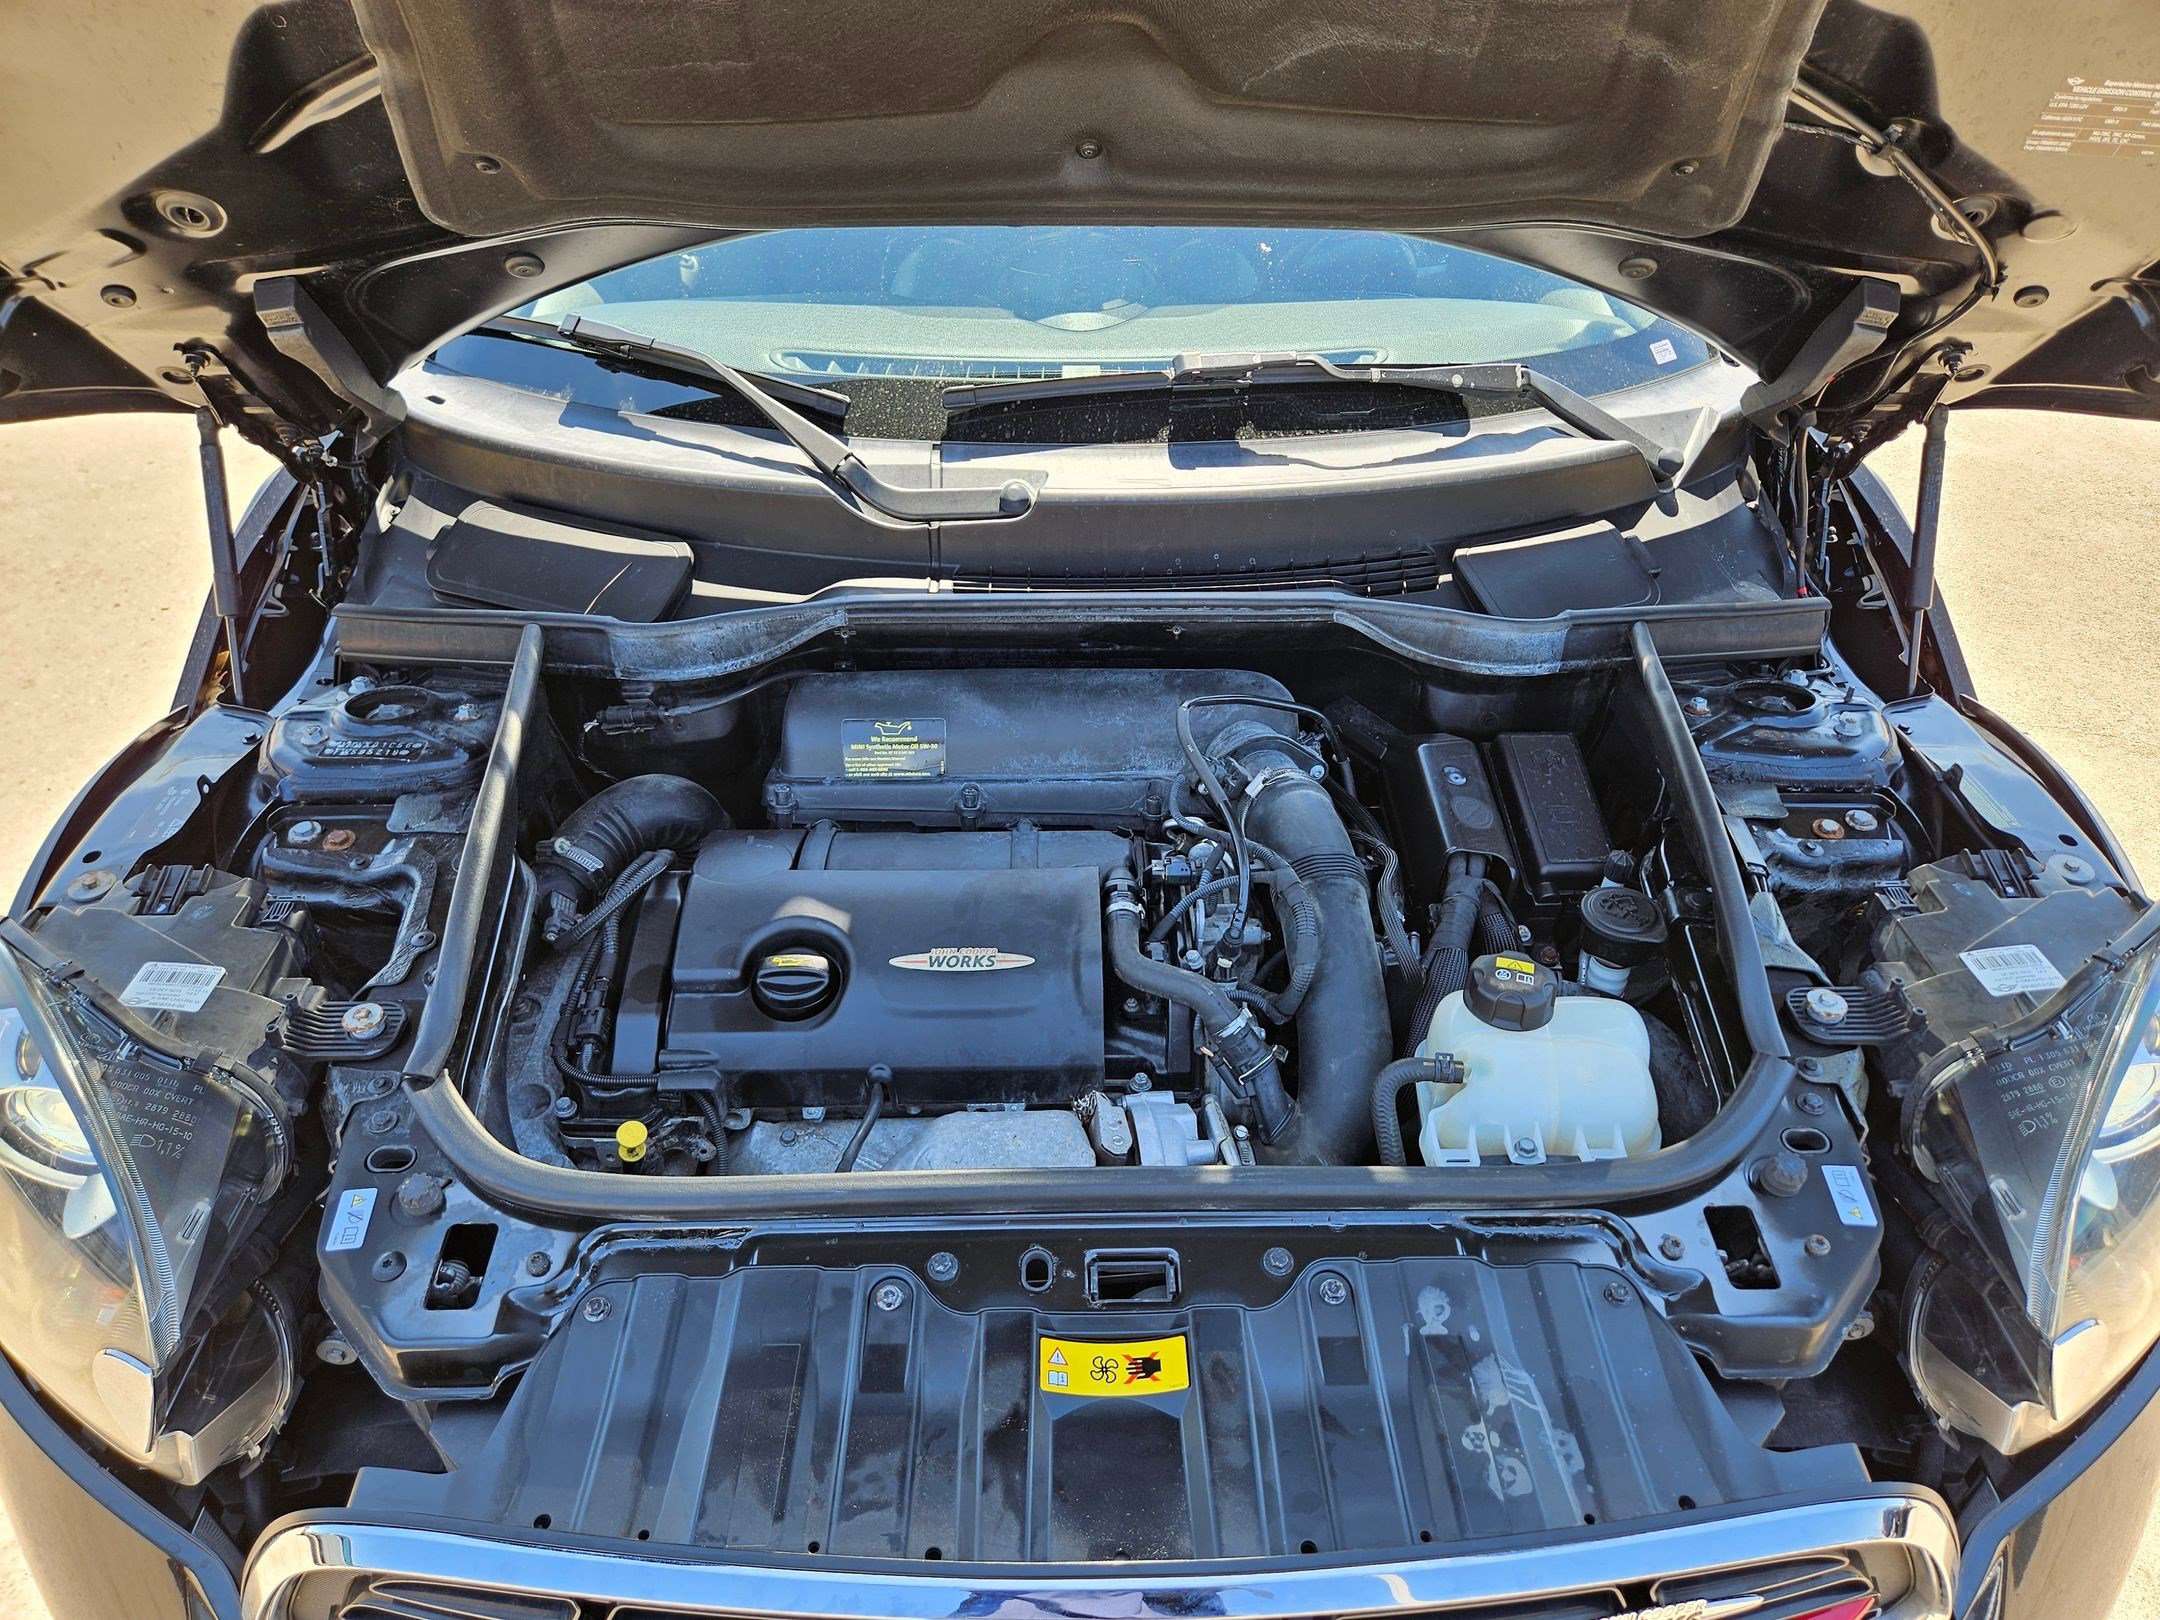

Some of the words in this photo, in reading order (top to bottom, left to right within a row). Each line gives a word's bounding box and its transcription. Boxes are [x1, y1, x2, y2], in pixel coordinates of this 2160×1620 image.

[2072, 86, 2096, 94] VEHICLE
[2096, 88, 2126, 96] EMISSION
[2125, 90, 2153, 98] CONTROL
[928, 955, 996, 968] WORKS
[2024, 1056, 2036, 1065] PL
[2046, 1050, 2062, 1060] 305
[2049, 1058, 2077, 1072] CVERT
[115, 1068, 131, 1078] 631
[193, 1084, 206, 1095] PL
[164, 1092, 195, 1106] CVERT
[144, 1102, 169, 1115] 2879
